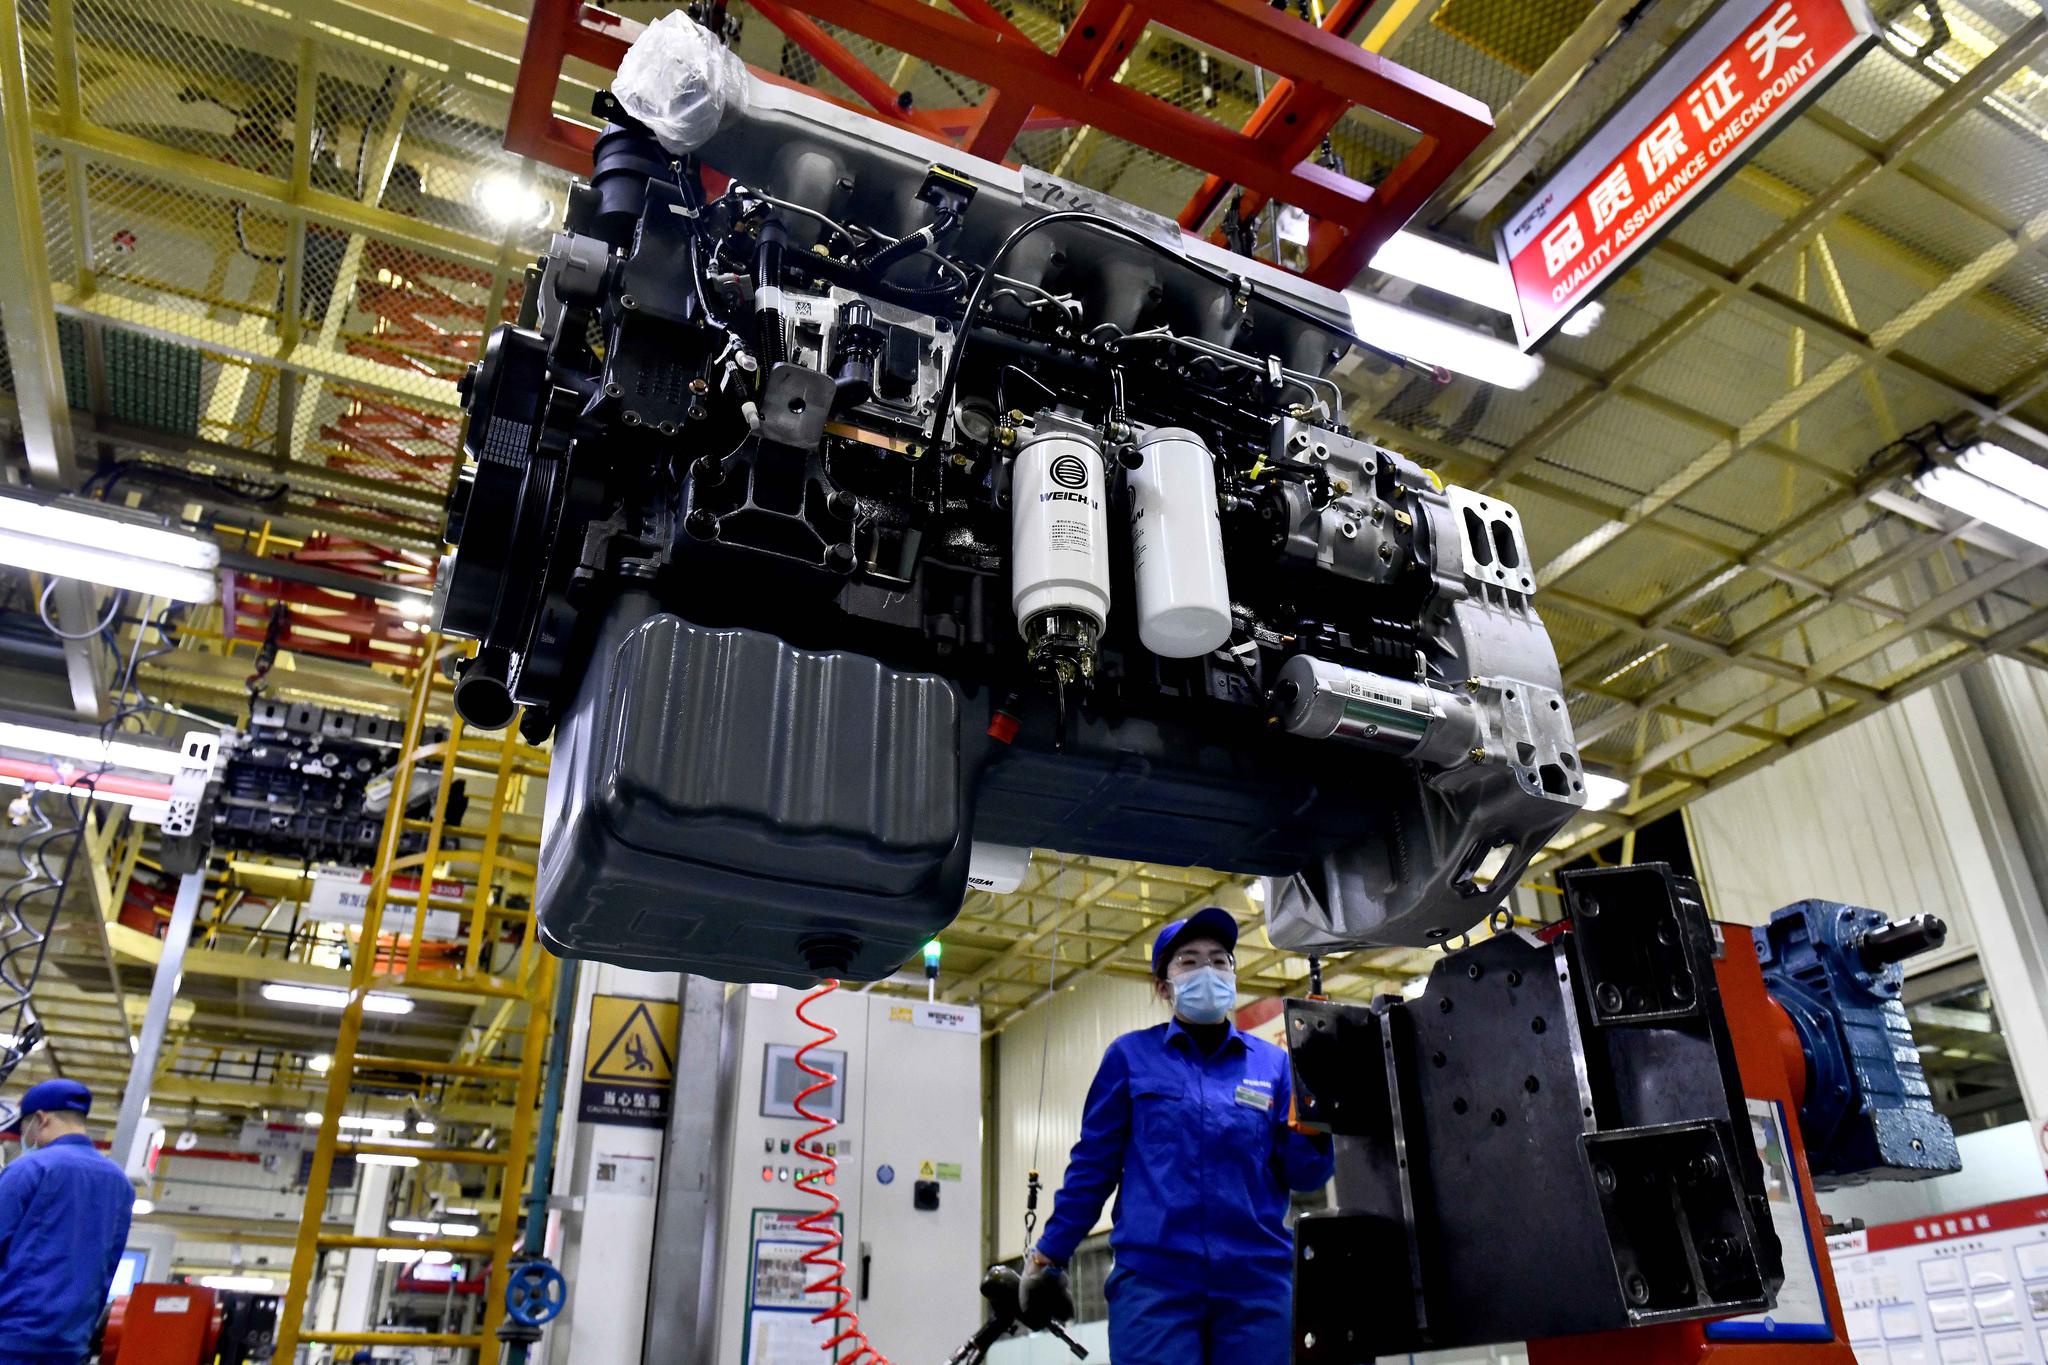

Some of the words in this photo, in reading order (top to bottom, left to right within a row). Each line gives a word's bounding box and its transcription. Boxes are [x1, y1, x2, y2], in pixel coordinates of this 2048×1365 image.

[1541, 1, 1806, 278] 品质保证关
[1551, 238, 1611, 304] QUALITY
[1615, 150, 1709, 248] ASSURANCE
[1708, 47, 1816, 158] CHECKPOINT
[1039, 491, 1098, 511] WEICHAI
[968, 877, 994, 887] WEI
